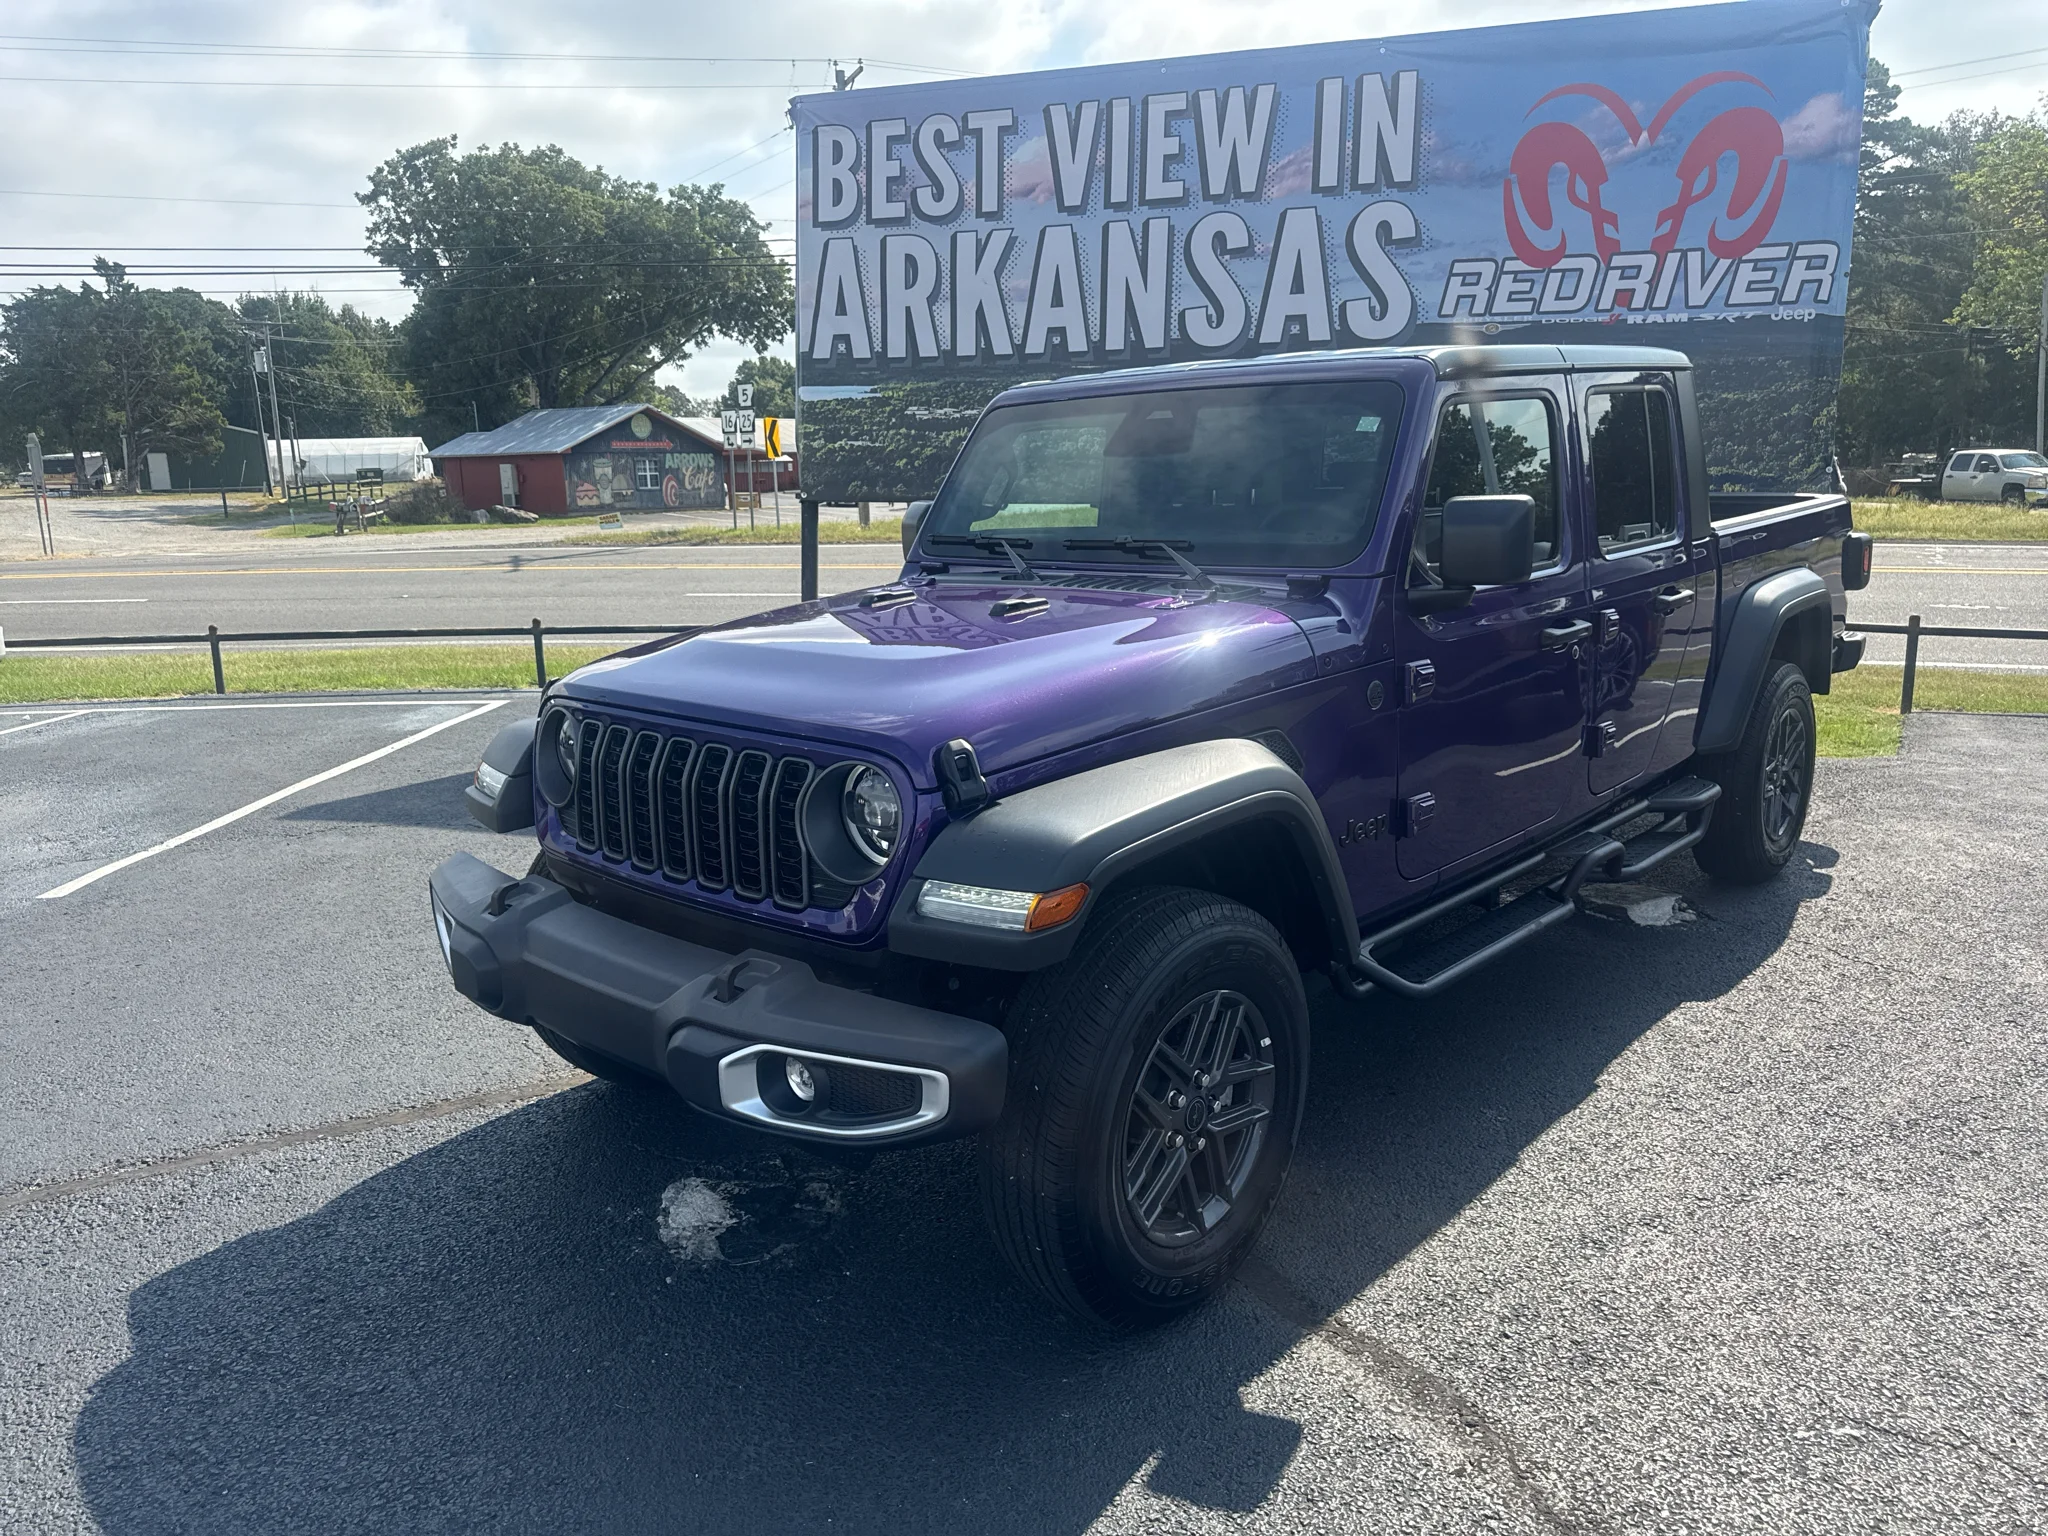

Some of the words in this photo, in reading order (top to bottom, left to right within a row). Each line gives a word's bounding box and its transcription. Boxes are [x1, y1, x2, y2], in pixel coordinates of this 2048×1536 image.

[811, 107, 1014, 227] BEST
[1043, 82, 1278, 213] VIEW
[1312, 68, 1420, 193] IN
[810, 199, 1422, 362] ARKANSAS
[1437, 239, 1841, 319] REDRIVER
[1452, 315, 1533, 324] CHRYSLER
[1541, 315, 1612, 325] DODGE
[1626, 312, 1689, 325] RAM
[1693, 310, 1763, 323] SRT
[1770, 306, 1816, 323] Jeep
[742, 388, 749, 403] 5
[724, 415, 734, 429] 16
[741, 414, 752, 429] 25
[665, 452, 716, 469] ARROWS
[682, 465, 715, 499] Cafe
[1338, 813, 1387, 848] Jeep
